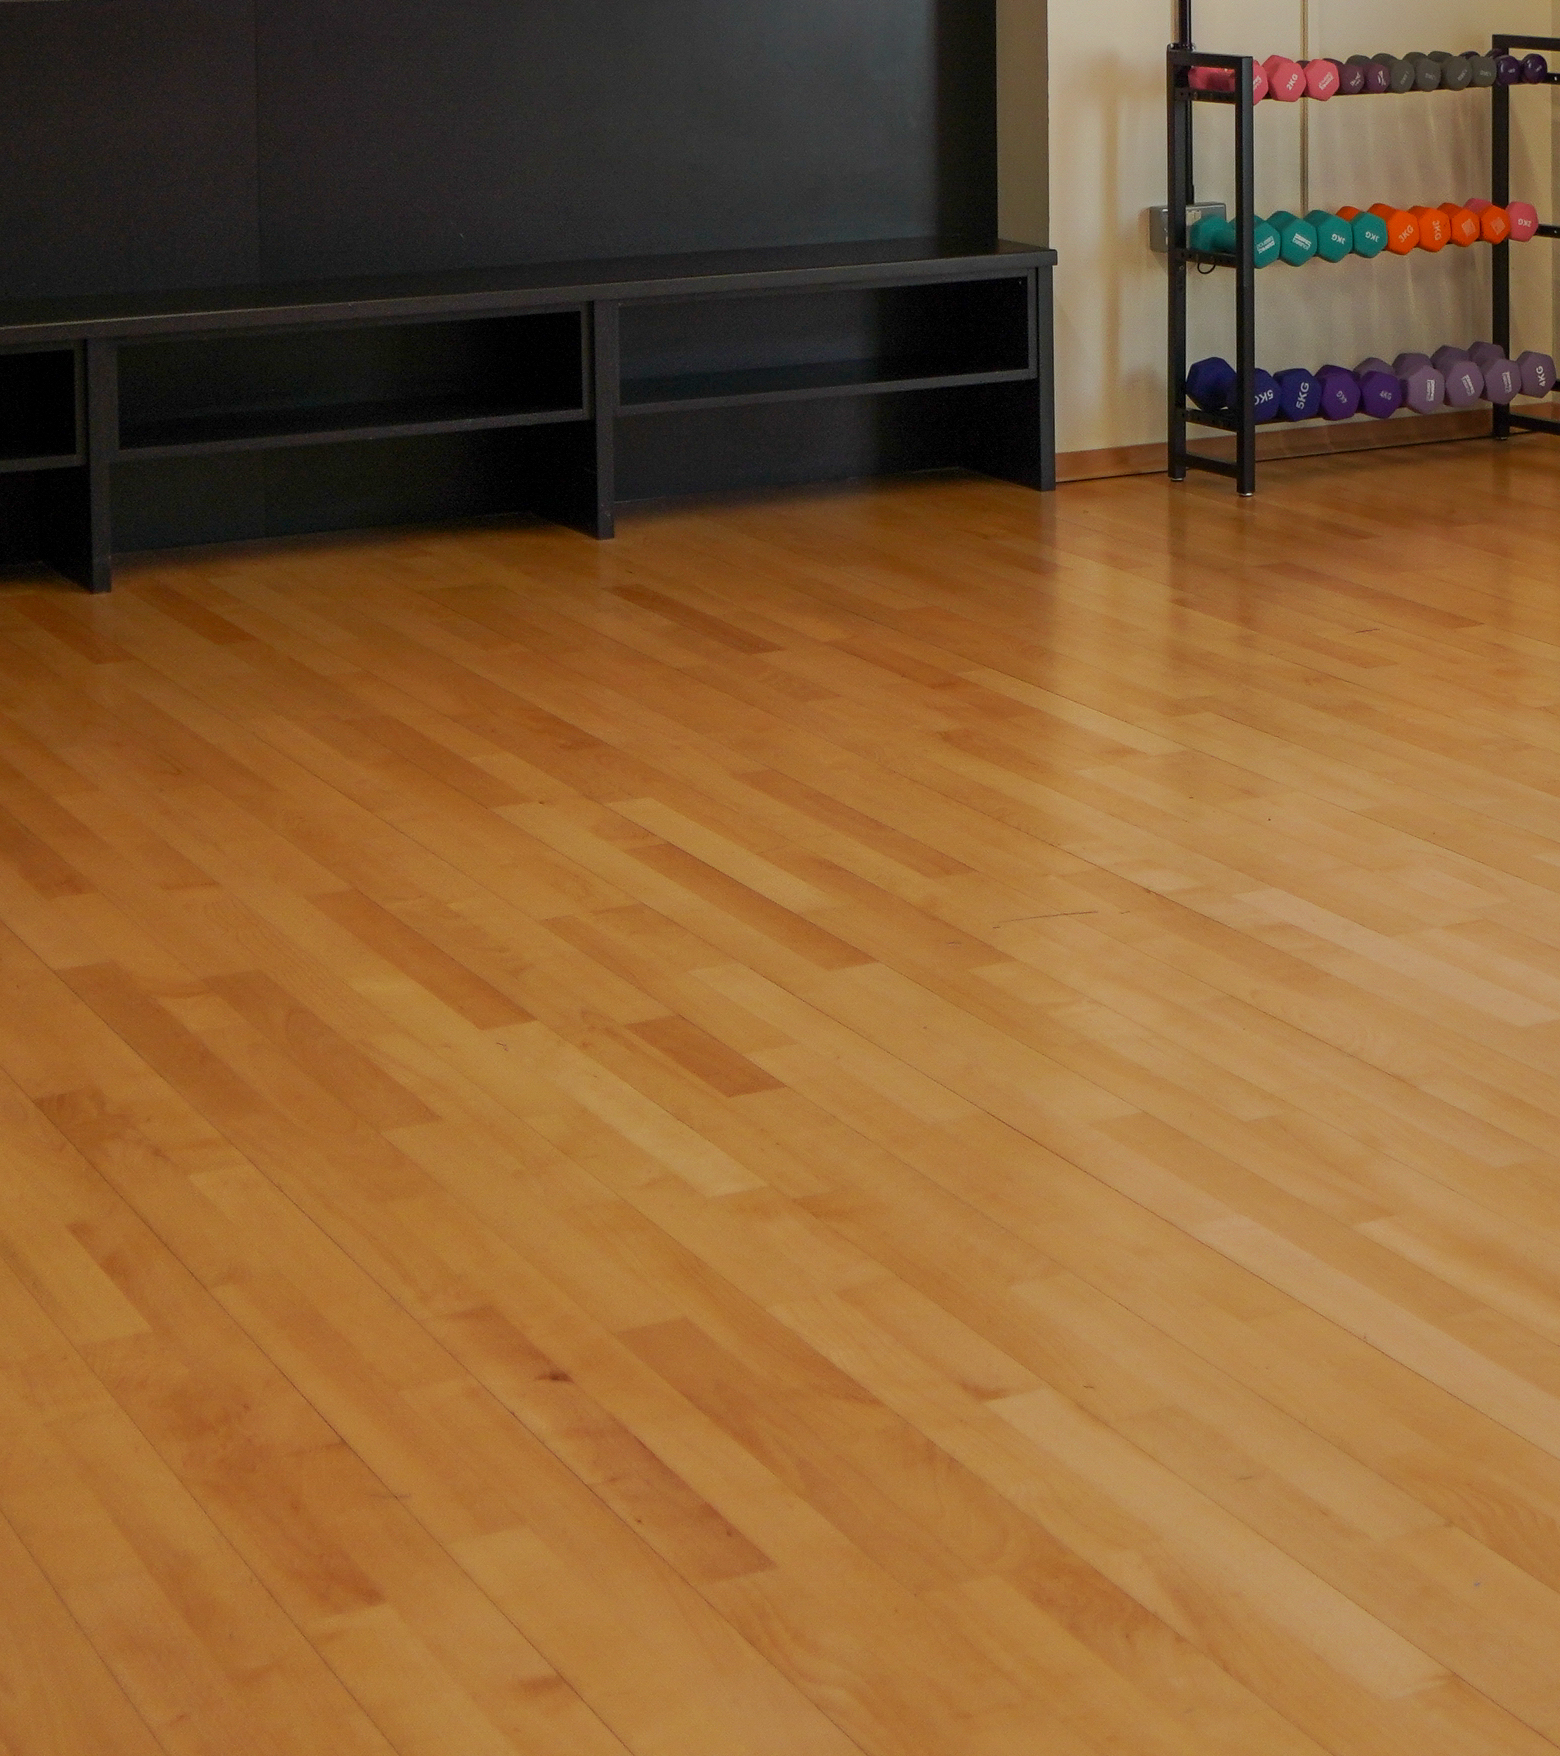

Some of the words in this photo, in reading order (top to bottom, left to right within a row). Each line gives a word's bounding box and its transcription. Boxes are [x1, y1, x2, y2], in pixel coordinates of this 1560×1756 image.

[1397, 224, 1415, 243] 3KG
[1431, 219, 1443, 242] 3KG
[1517, 218, 1533, 228] 2KG
[1535, 364, 1547, 388] 4KG
[1295, 381, 1311, 411] 5KG
